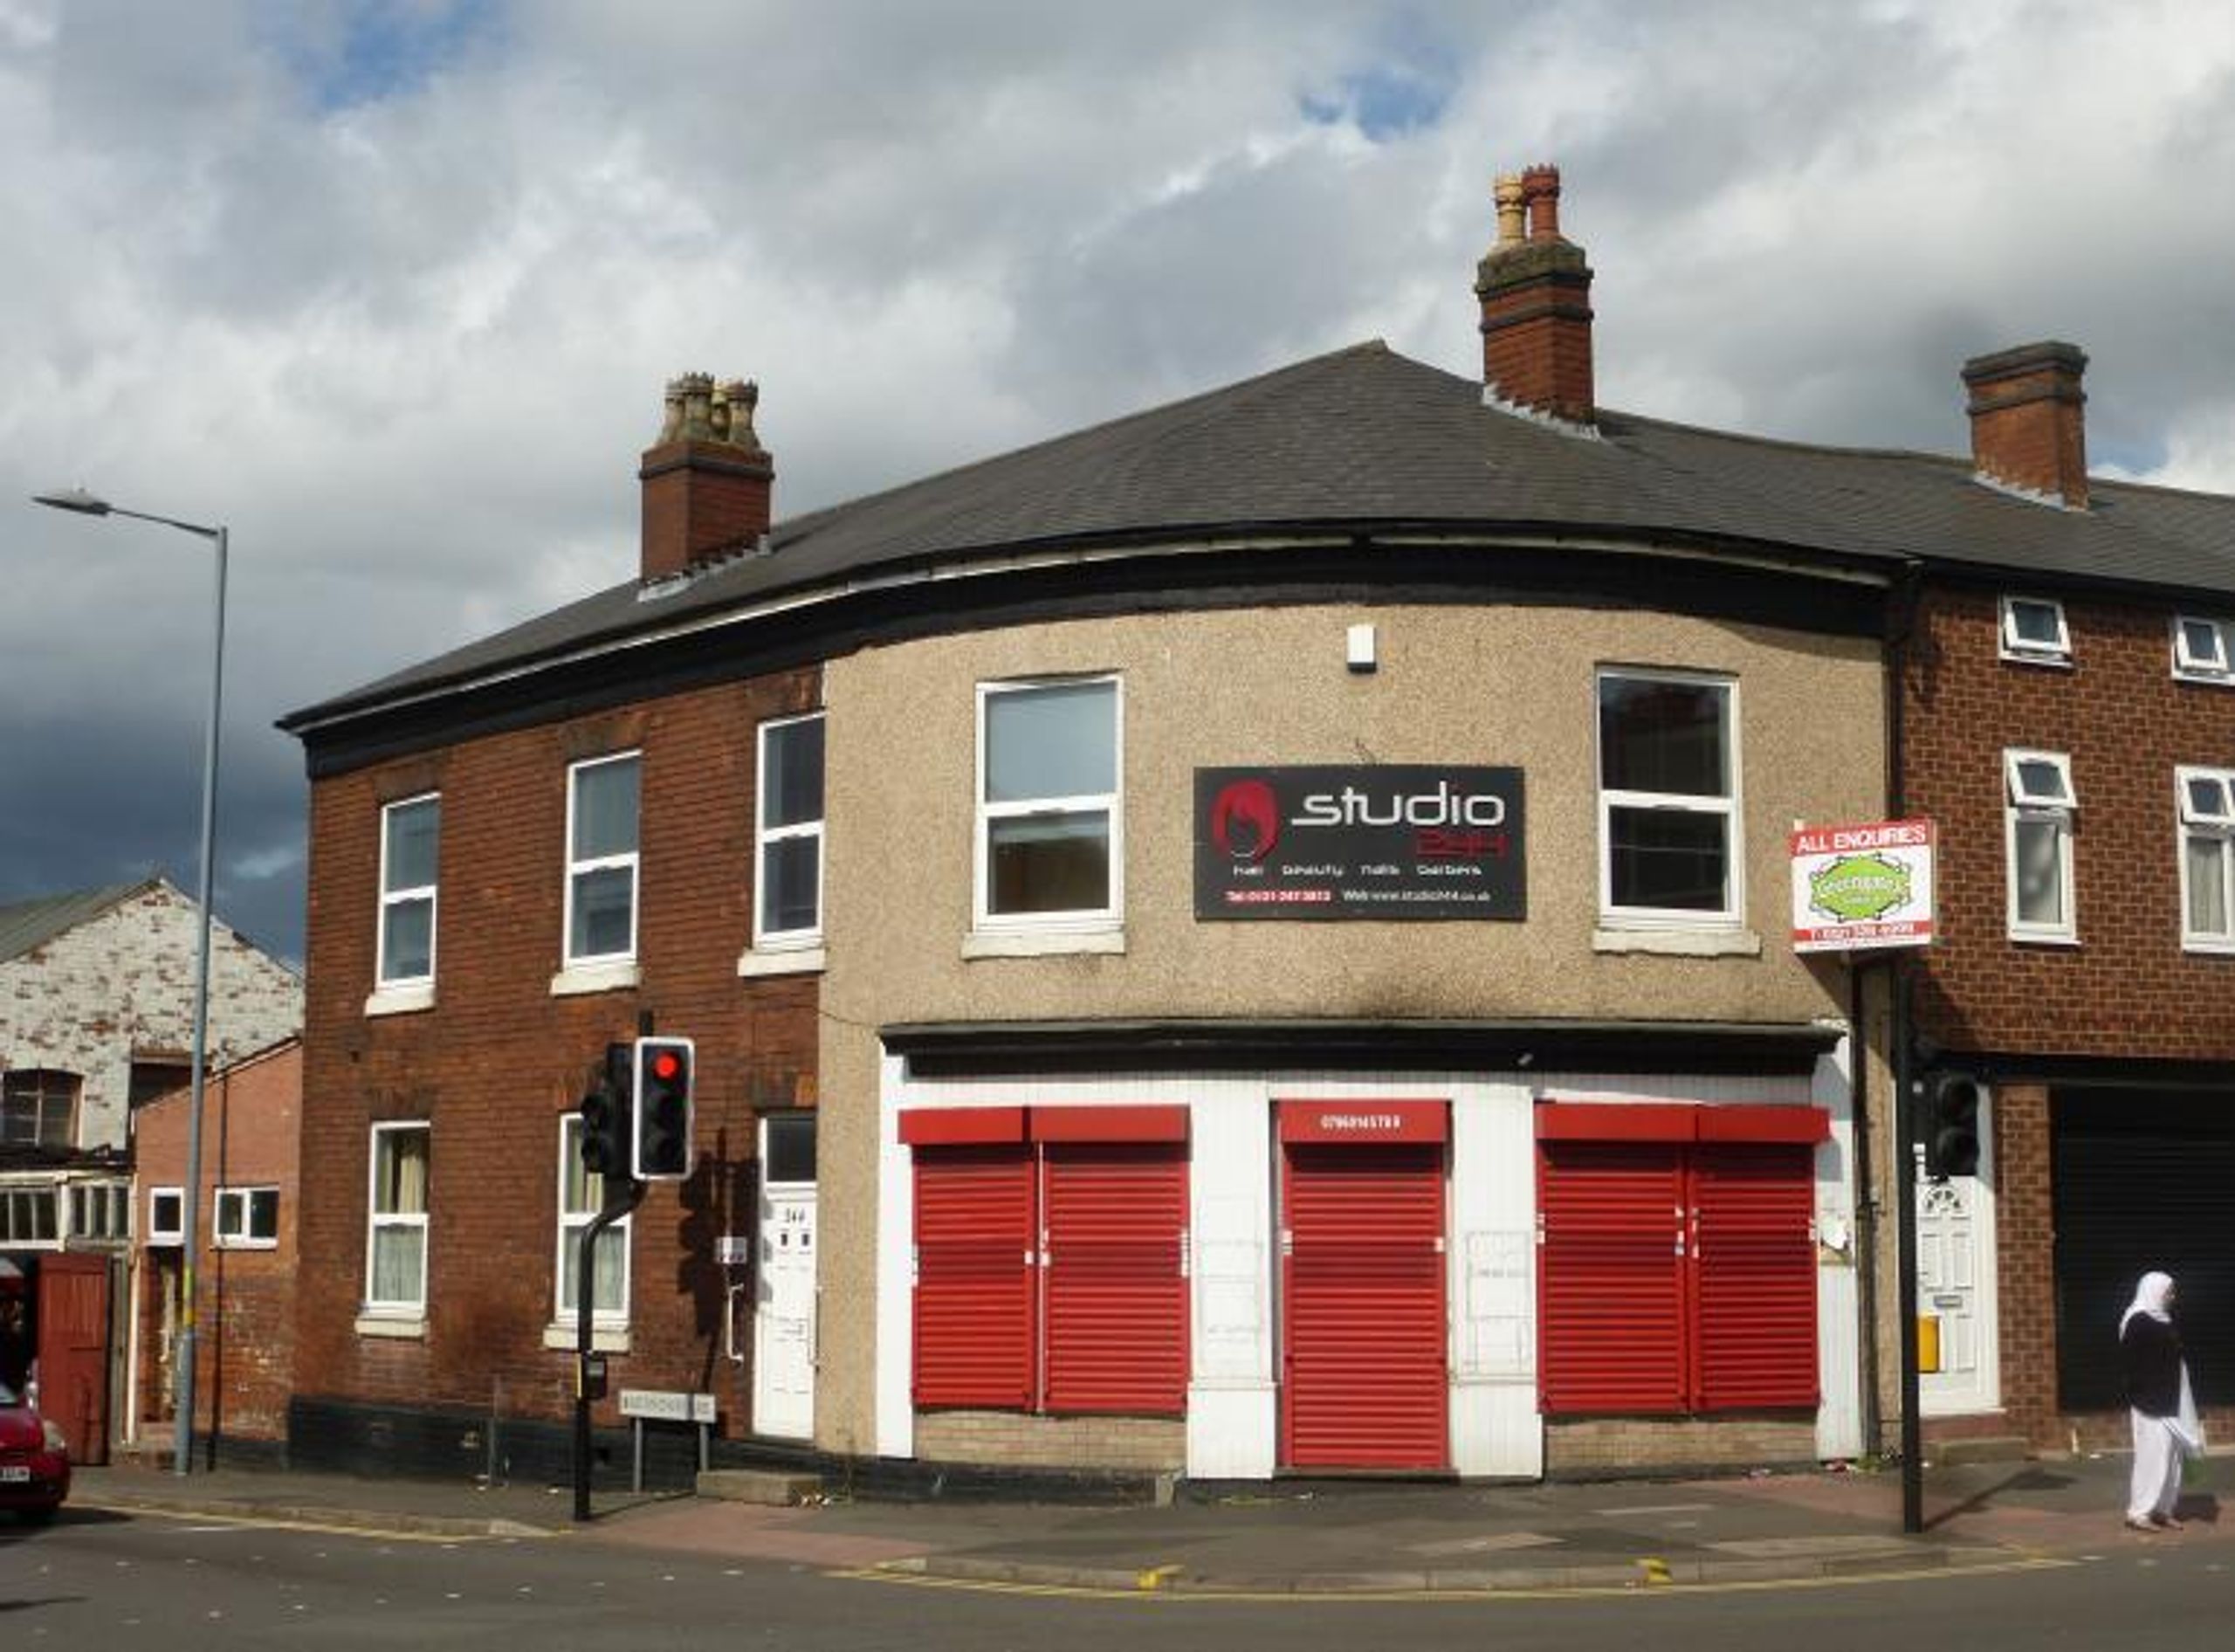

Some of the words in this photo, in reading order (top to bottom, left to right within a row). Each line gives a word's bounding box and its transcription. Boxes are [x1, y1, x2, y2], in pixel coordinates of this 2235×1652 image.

[1291, 781, 1505, 826] studio
[1797, 836, 1829, 855] ALL
[1282, 863, 1344, 878] beauty
[1360, 863, 1401, 876] nails
